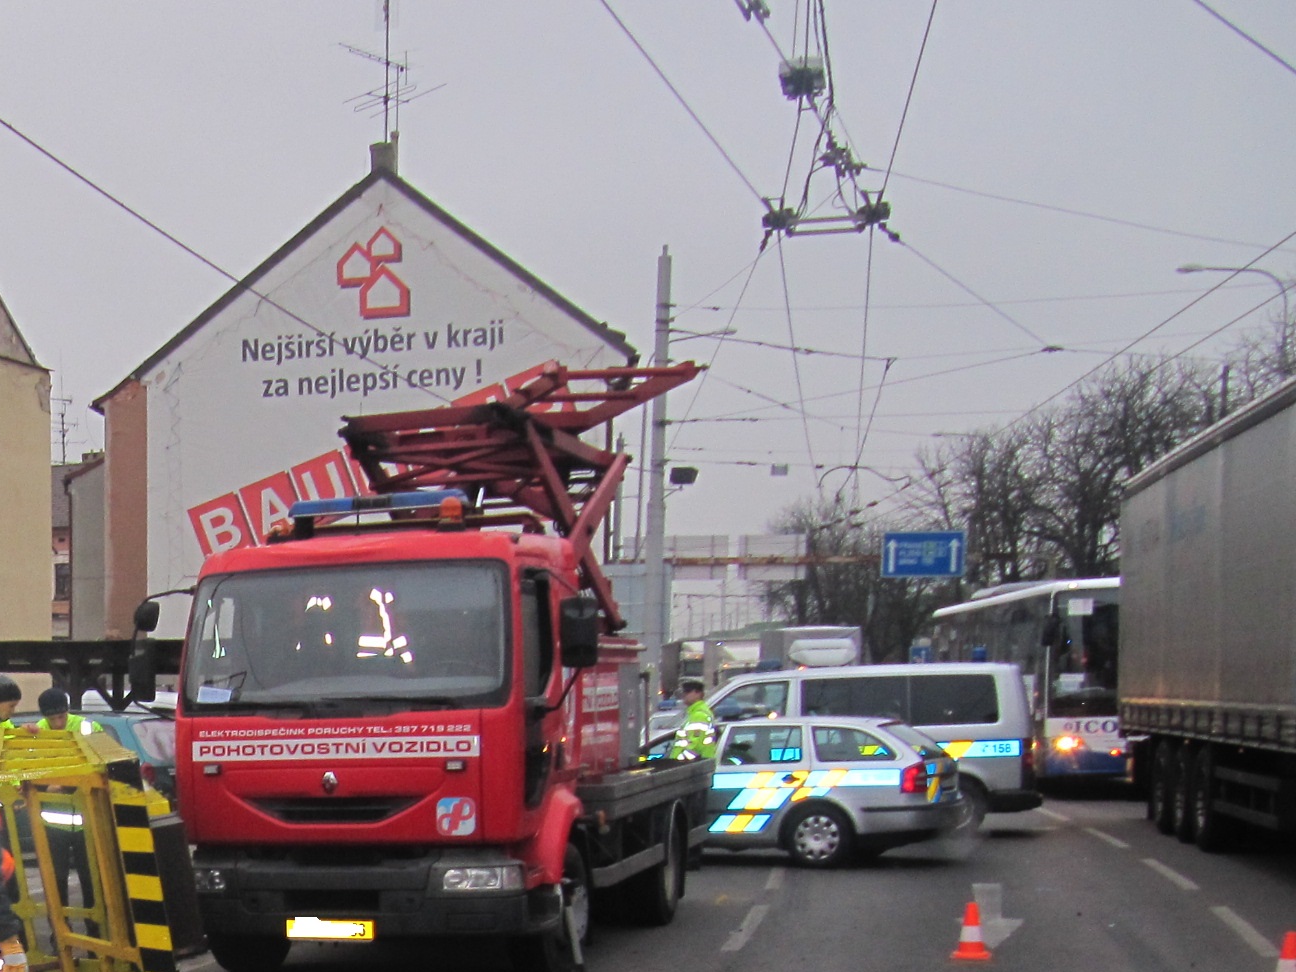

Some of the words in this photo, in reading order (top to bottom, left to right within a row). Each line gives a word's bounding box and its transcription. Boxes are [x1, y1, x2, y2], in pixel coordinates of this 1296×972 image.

[242, 331, 335, 366] Nejširší
[342, 326, 416, 359] výběr
[424, 331, 438, 350] v
[447, 318, 504, 351] kraji
[262, 377, 289, 398] za
[298, 363, 399, 399] nejlepší
[407, 365, 465, 391] ceny
[475, 358, 482, 384] !
[307, 726, 364, 736] PORUCHY
[446, 724, 472, 732] 222
[199, 738, 366, 757] POHOTOVOSTNÍ
[372, 739, 472, 754] VOZIDLO
[992, 743, 1012, 753] 158
